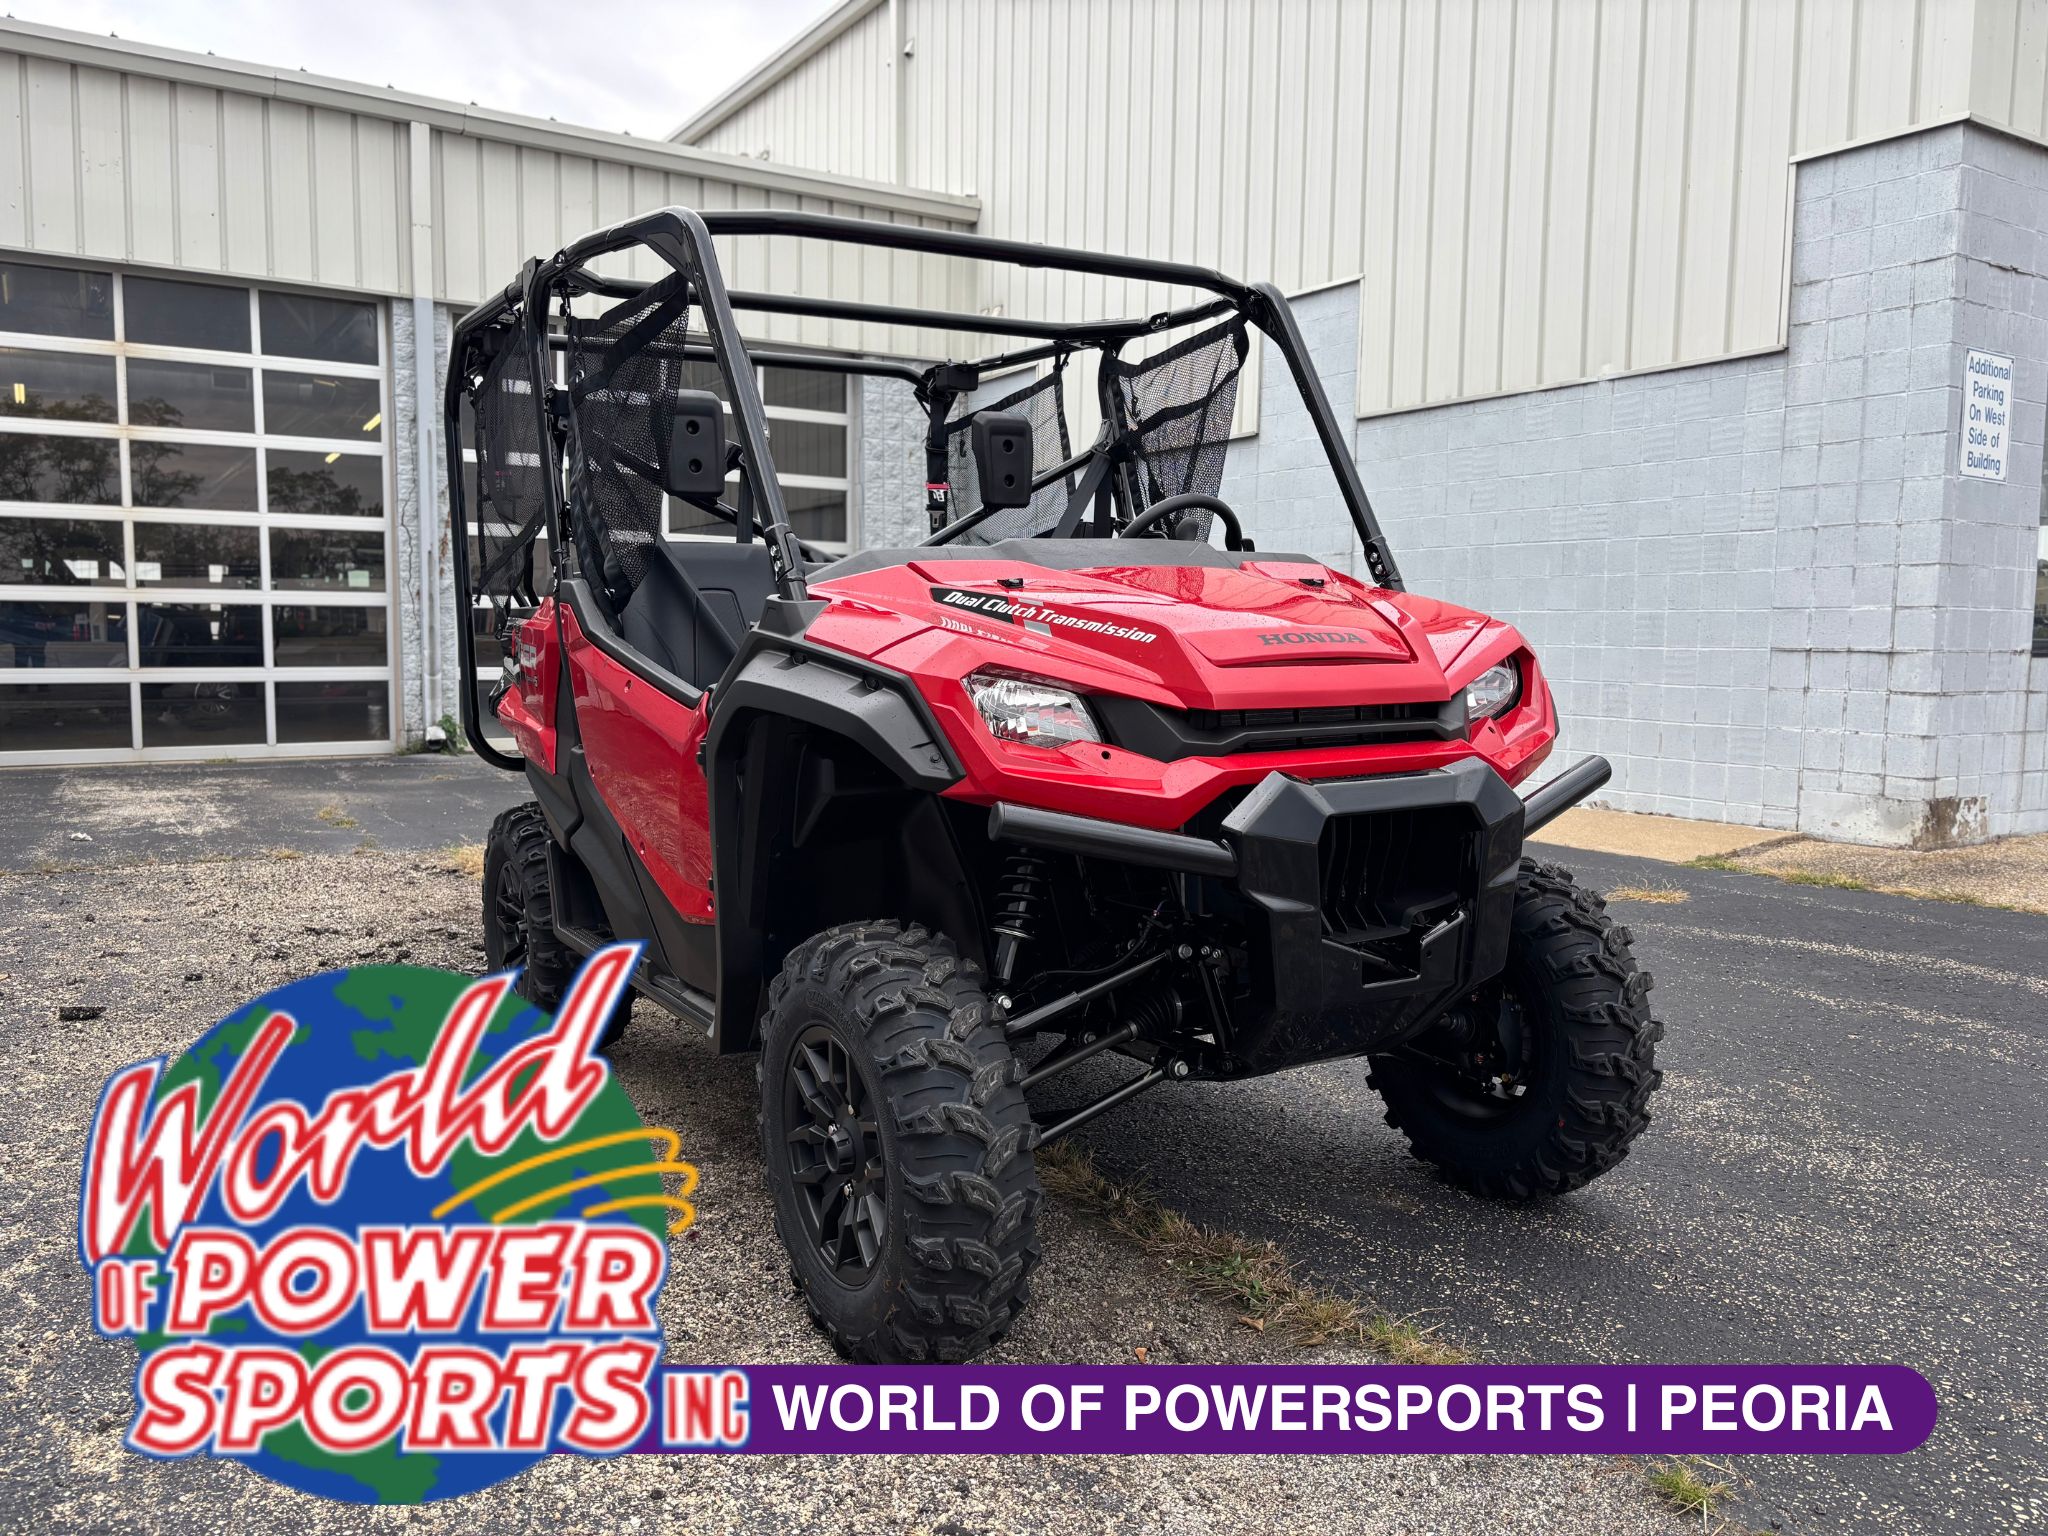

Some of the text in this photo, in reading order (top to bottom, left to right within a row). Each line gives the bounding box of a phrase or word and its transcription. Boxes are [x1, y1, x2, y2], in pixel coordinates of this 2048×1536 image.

[1968, 356, 2012, 381] Additional
[1972, 381, 2004, 406] Parking
[1969, 404, 2006, 426] On West
[1968, 427, 2000, 448] Side of
[1967, 451, 2001, 475] Building
[942, 591, 982, 608] Dual
[982, 598, 1037, 619] Clutch
[1035, 608, 1158, 644] Transmission
[1257, 632, 1367, 646] HONDA
